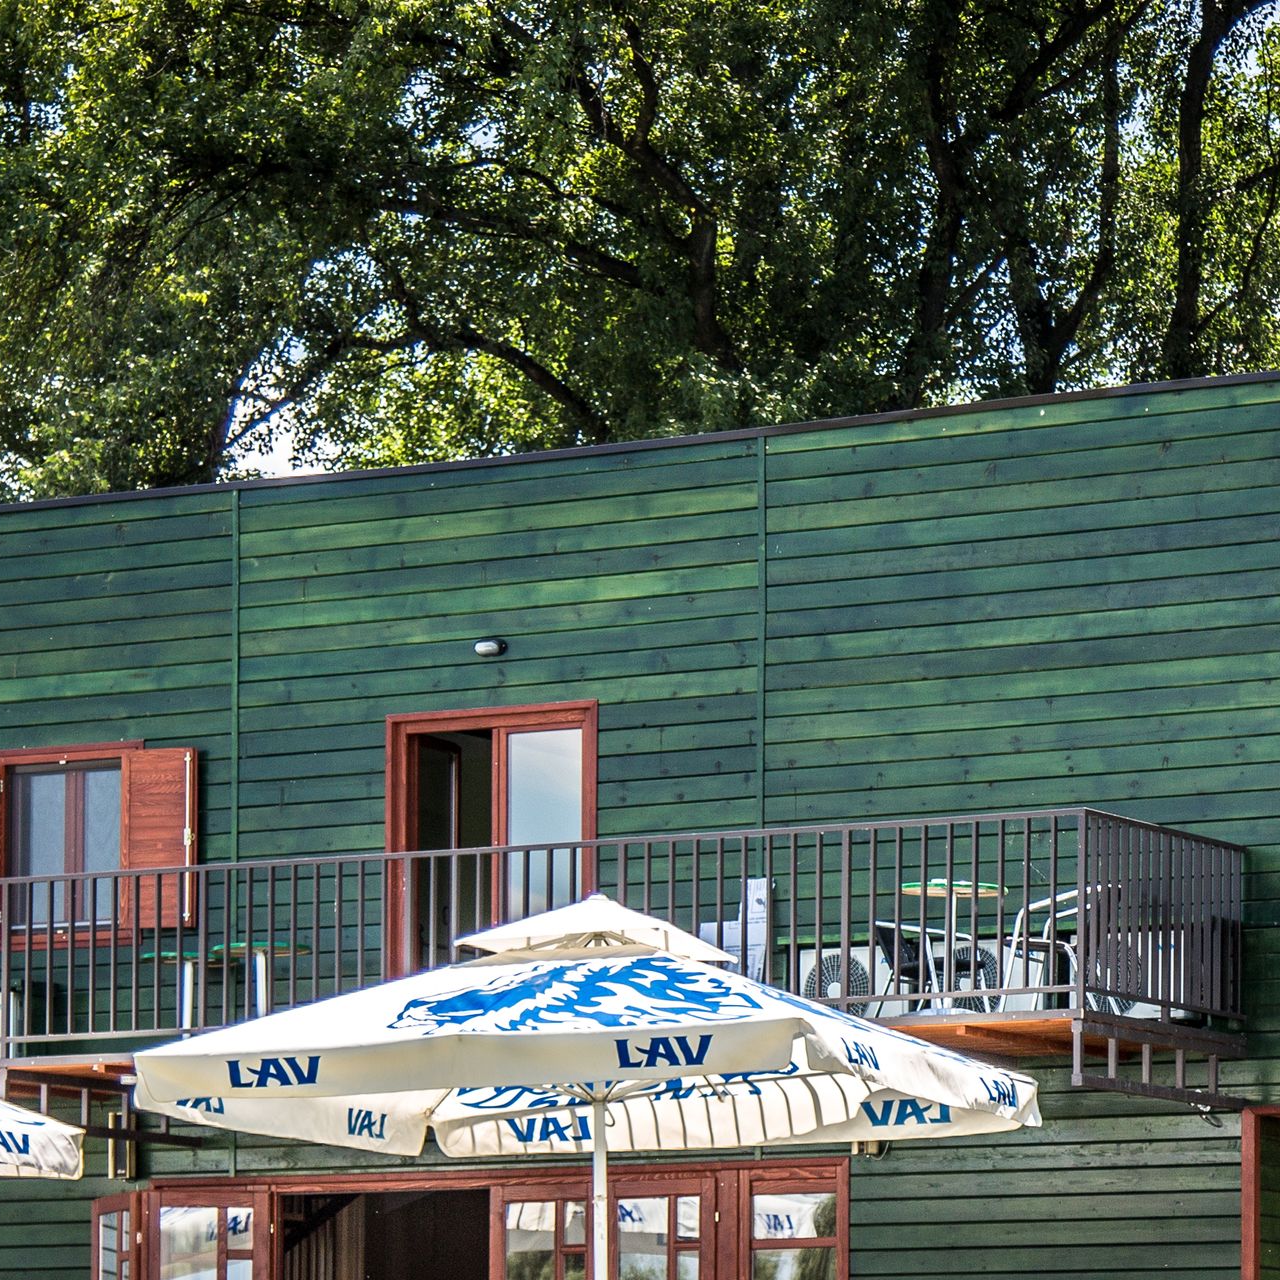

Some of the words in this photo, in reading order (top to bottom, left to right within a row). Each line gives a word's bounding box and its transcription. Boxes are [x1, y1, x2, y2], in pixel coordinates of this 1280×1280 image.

[614, 1034, 714, 1069] LAV
[841, 1037, 881, 1071] LAV
[225, 1055, 321, 1088] LAV
[979, 1076, 1017, 1108] LAV
